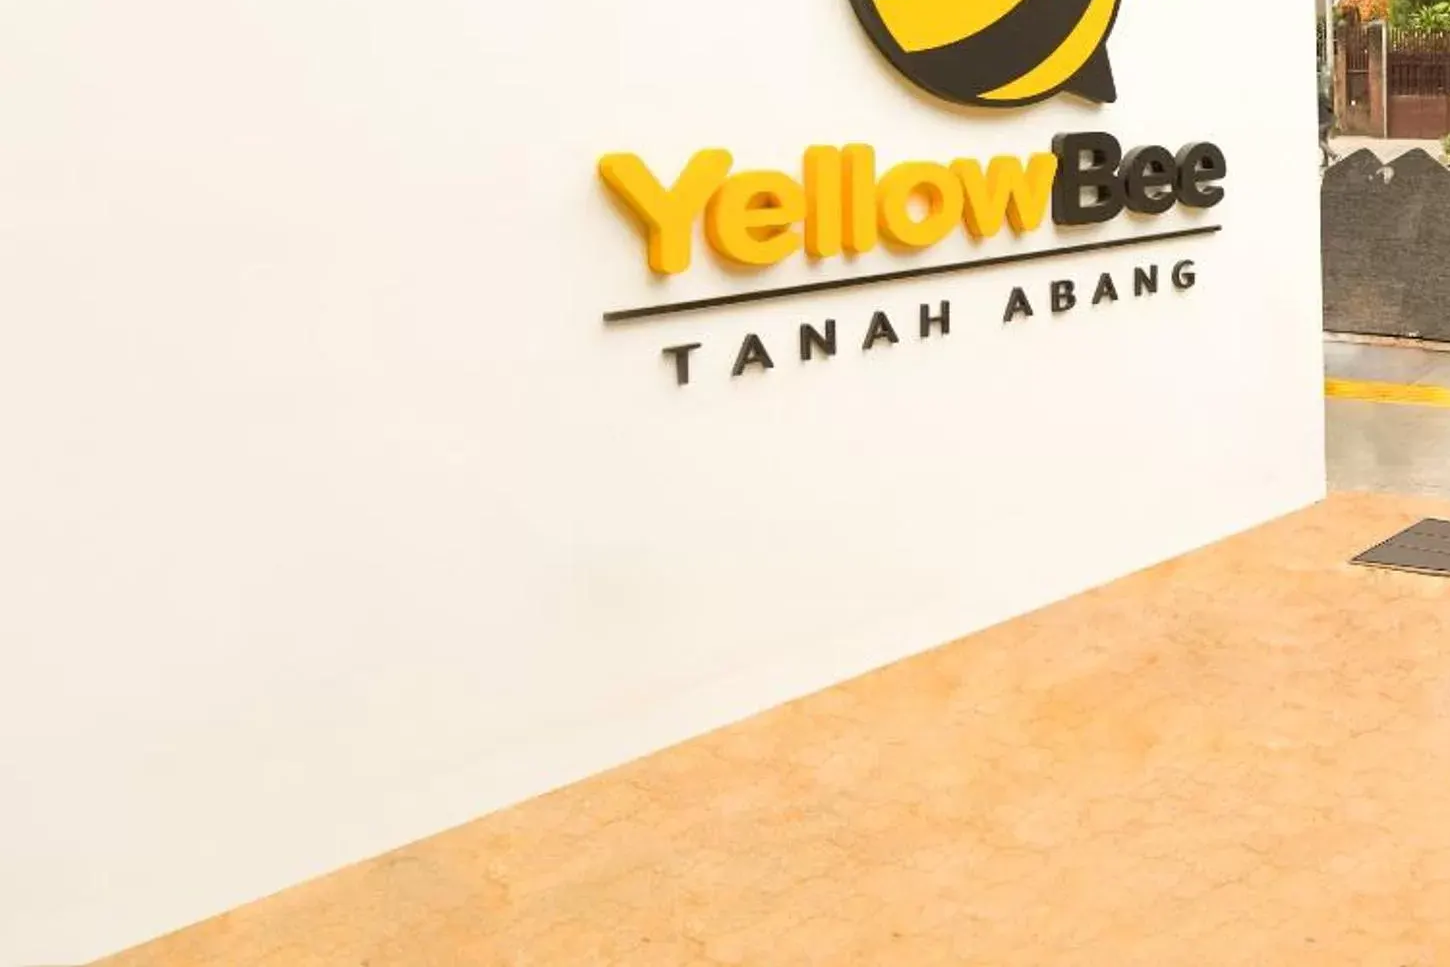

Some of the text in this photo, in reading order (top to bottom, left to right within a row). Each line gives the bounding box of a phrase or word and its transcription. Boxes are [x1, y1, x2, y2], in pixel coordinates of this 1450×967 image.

[597, 131, 1227, 274] YellowBee
[662, 260, 1197, 385] TANAH ABANG
